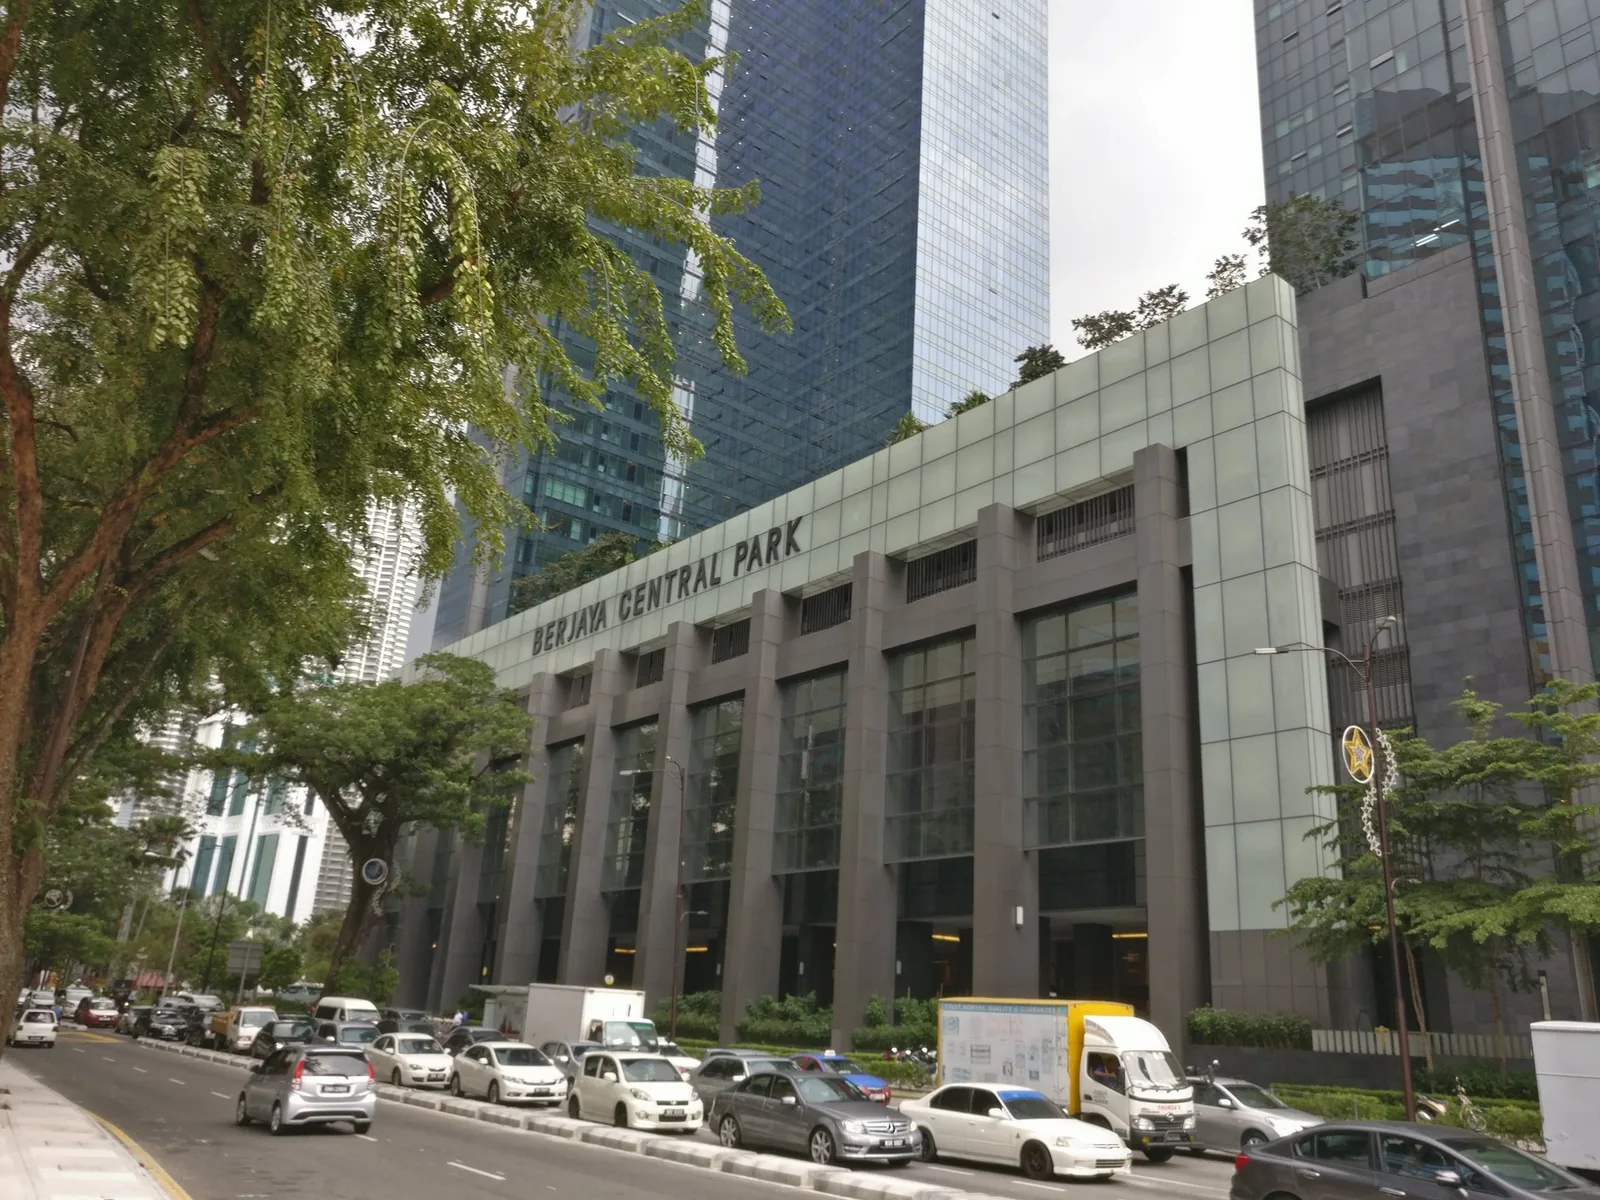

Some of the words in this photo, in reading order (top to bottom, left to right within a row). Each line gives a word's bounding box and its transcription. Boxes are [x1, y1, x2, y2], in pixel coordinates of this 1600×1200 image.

[532, 599, 607, 656] BERJAYA
[618, 552, 721, 621] CENTRAL
[733, 515, 803, 577] PARK
